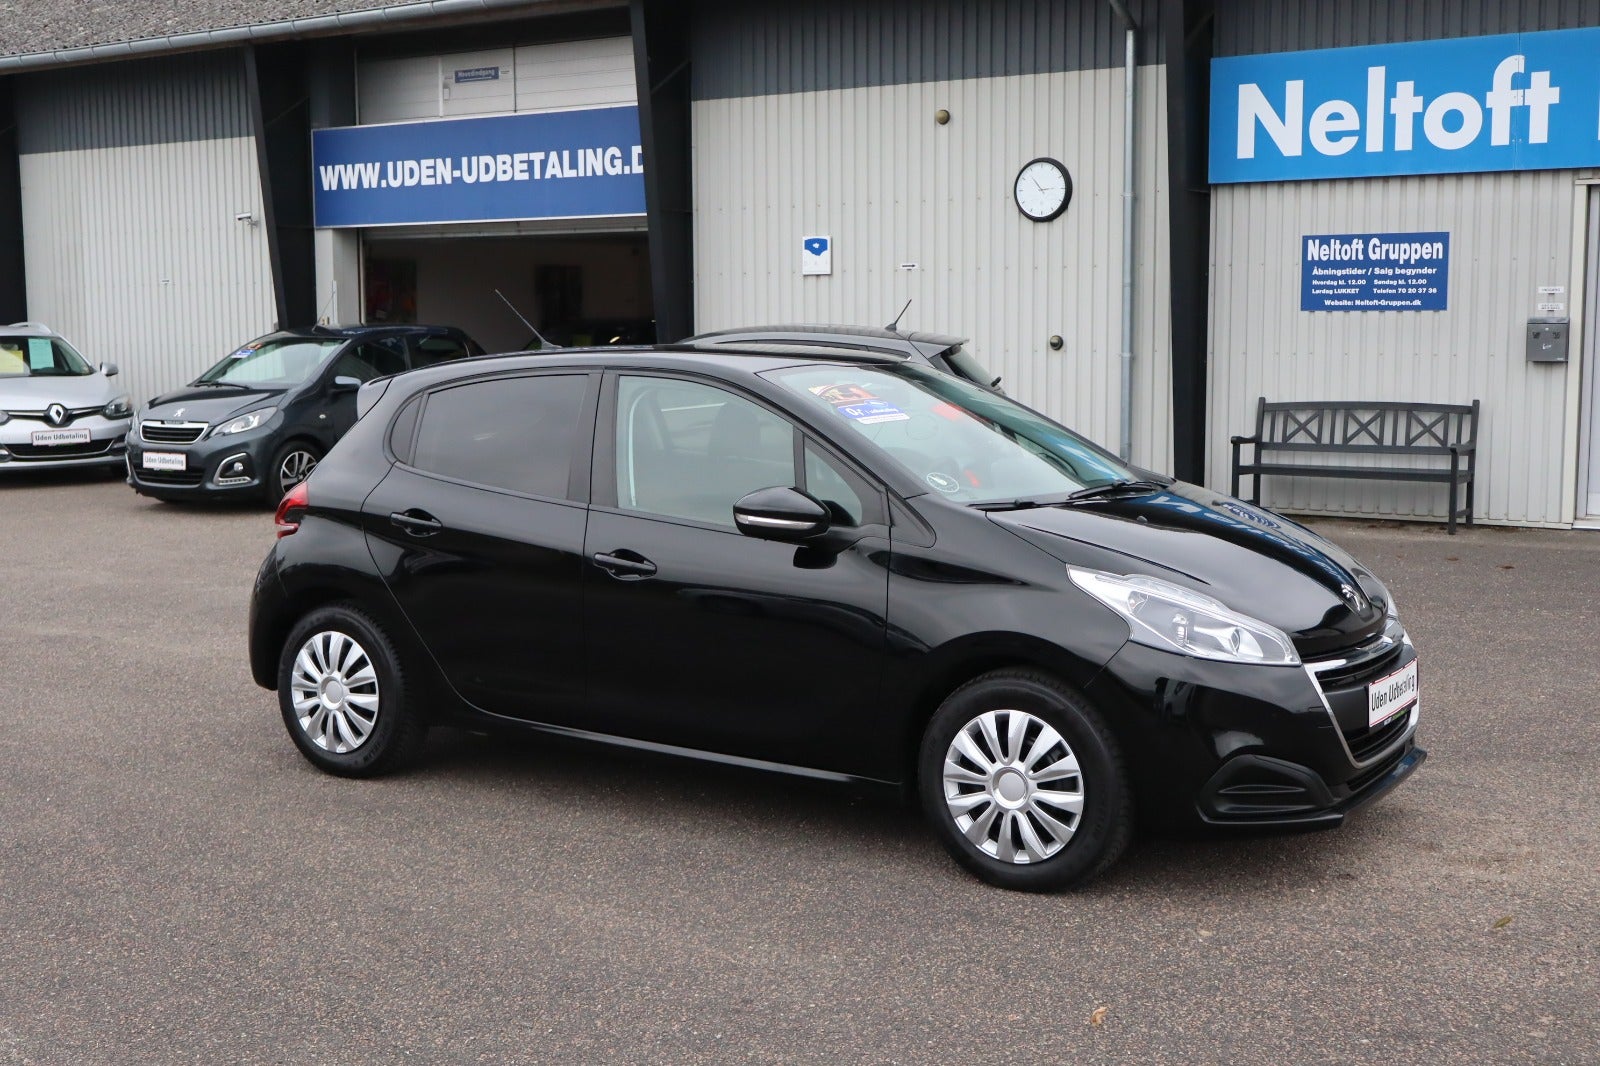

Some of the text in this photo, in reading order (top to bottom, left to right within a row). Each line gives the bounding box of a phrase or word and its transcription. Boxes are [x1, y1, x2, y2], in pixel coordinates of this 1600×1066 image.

[1237, 54, 1560, 159] Neltoft
[1307, 237, 1443, 264] Neltoft Gruppen
[1312, 265, 1437, 276] Åbningstider / Salg begynder
[53, 432, 88, 440] Udbetaling
[1371, 690, 1388, 711] Uden
